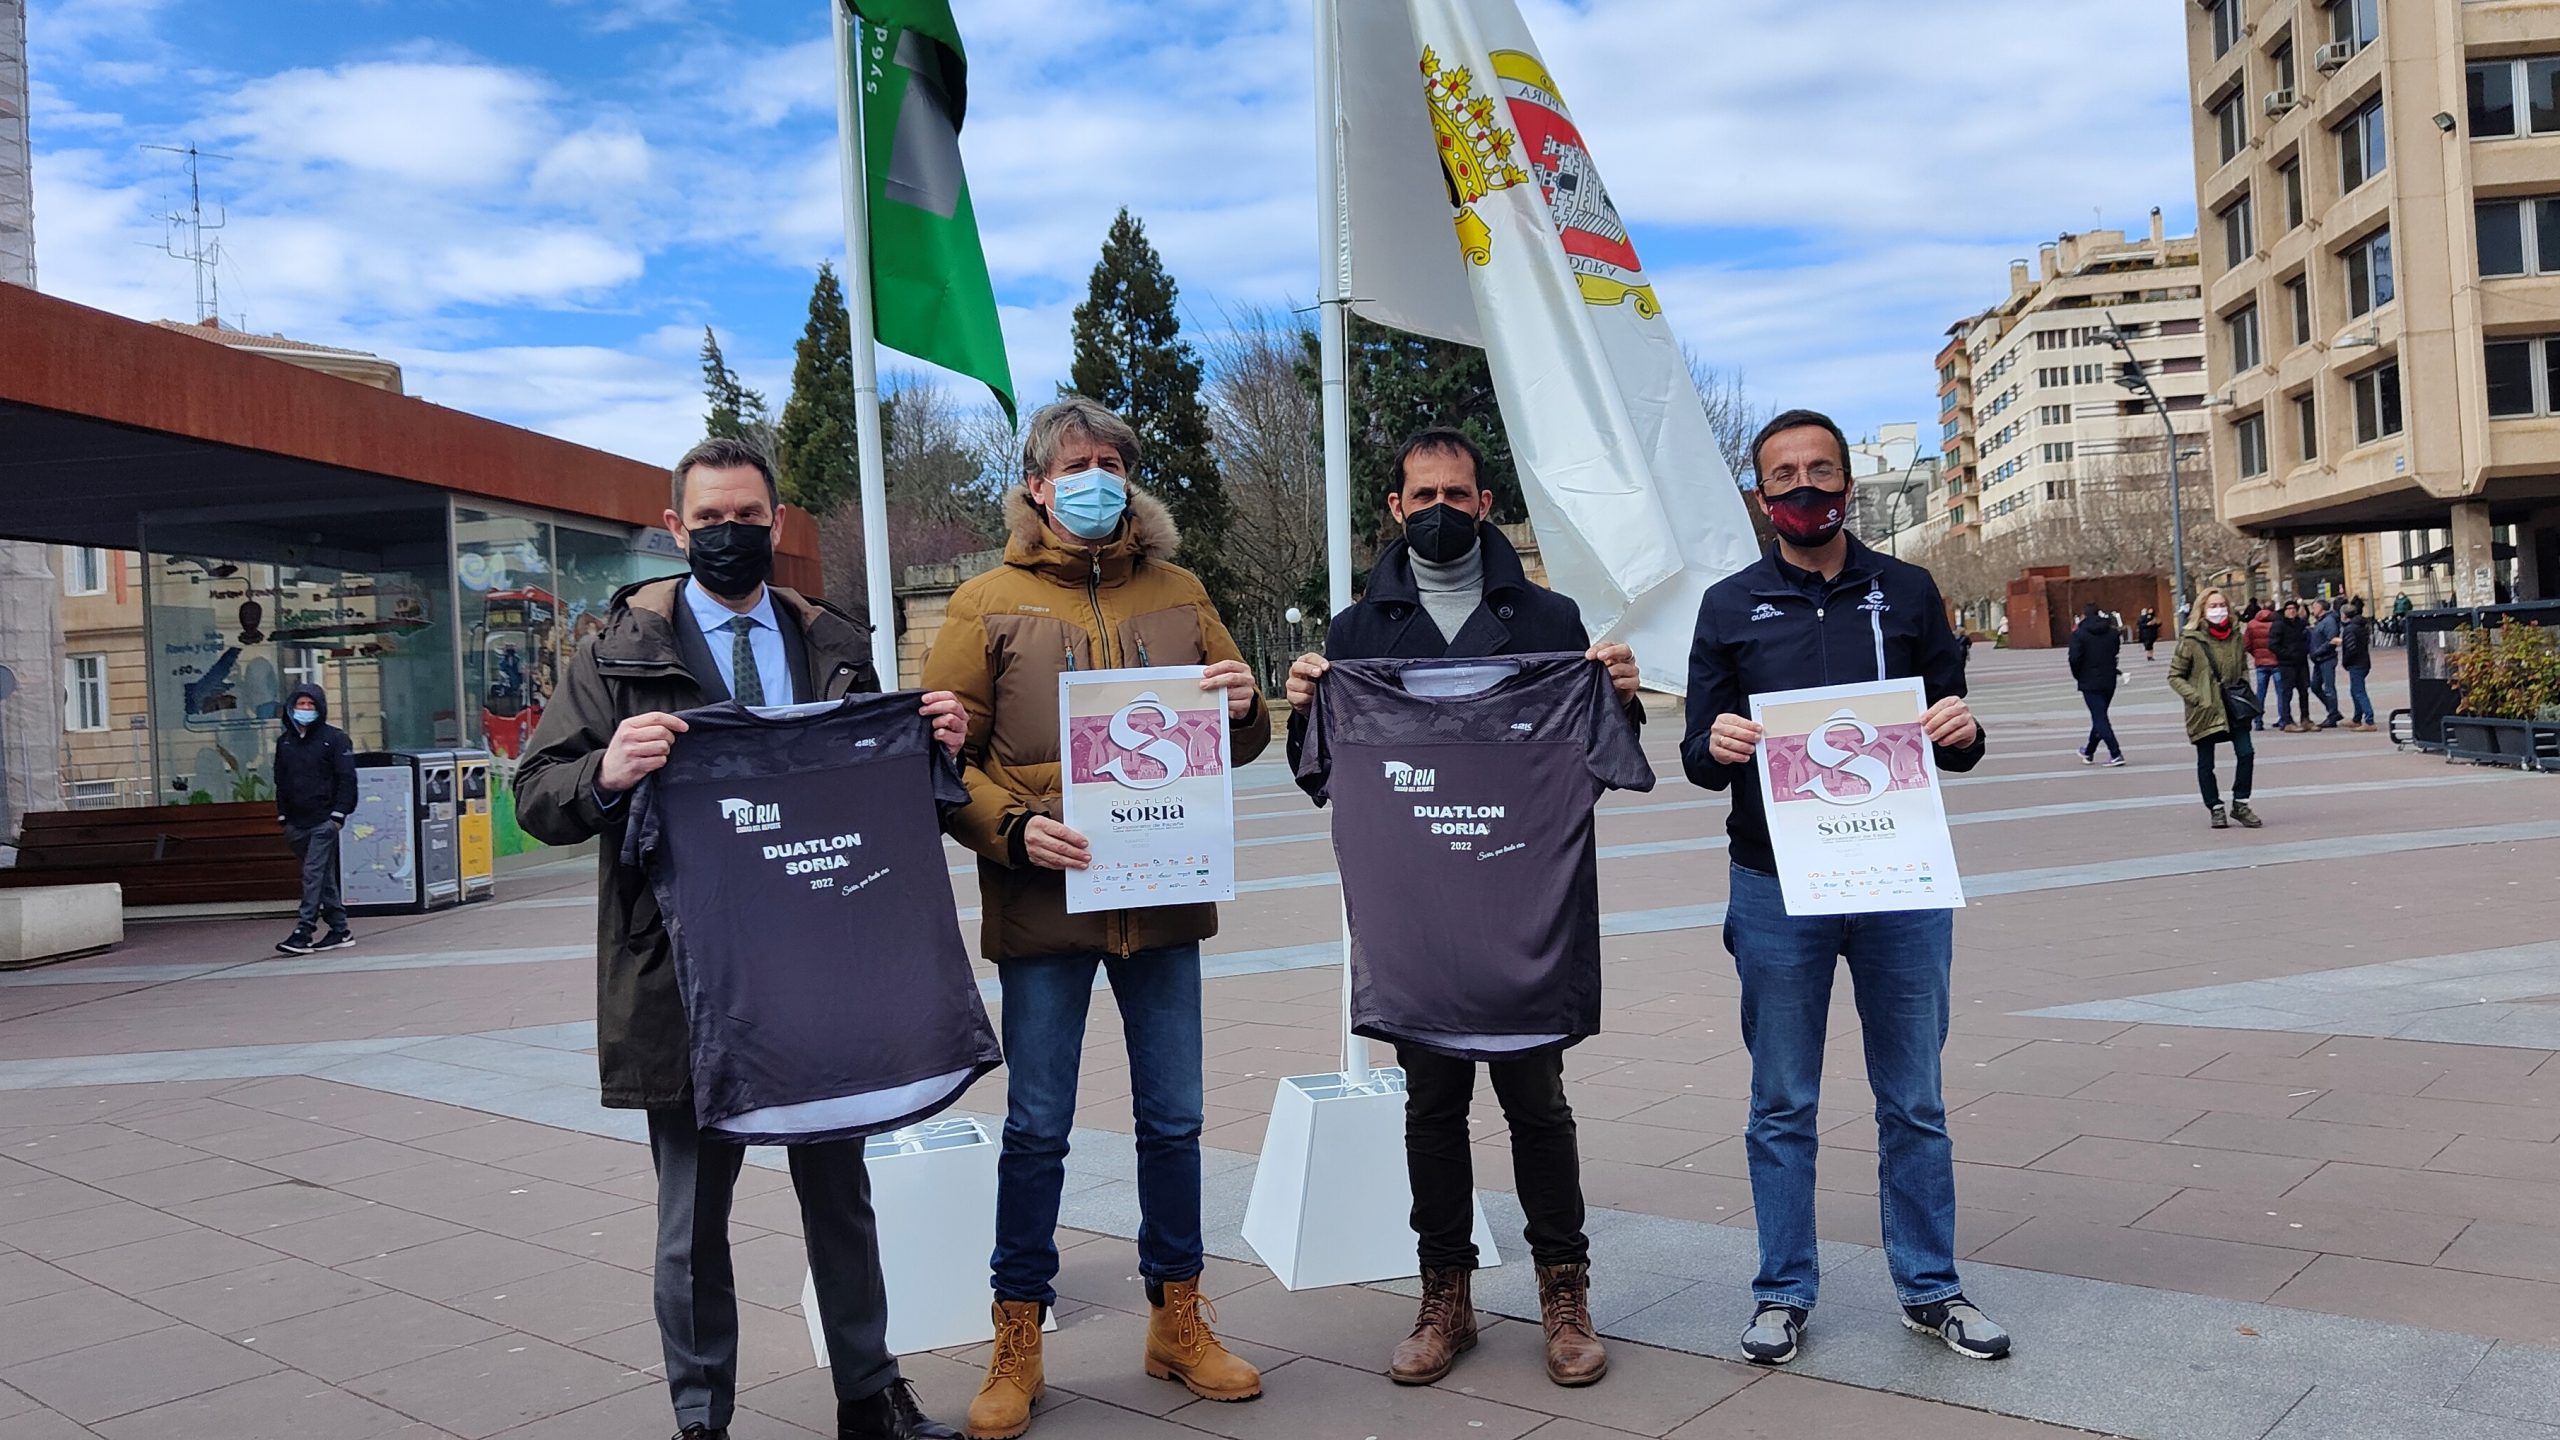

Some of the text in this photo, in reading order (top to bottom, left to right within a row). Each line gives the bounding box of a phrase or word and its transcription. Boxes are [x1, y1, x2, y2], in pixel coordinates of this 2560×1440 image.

[1395, 768, 1435, 786] SORIA
[735, 803, 781, 826] SORIA
[1413, 806, 1505, 819] DUATLON
[1430, 822, 1489, 835] SORIA
[762, 833, 862, 860] DUATLON
[1450, 842, 1472, 850] 2022
[785, 855, 849, 875] SORIA
[810, 878, 834, 890] 2022
